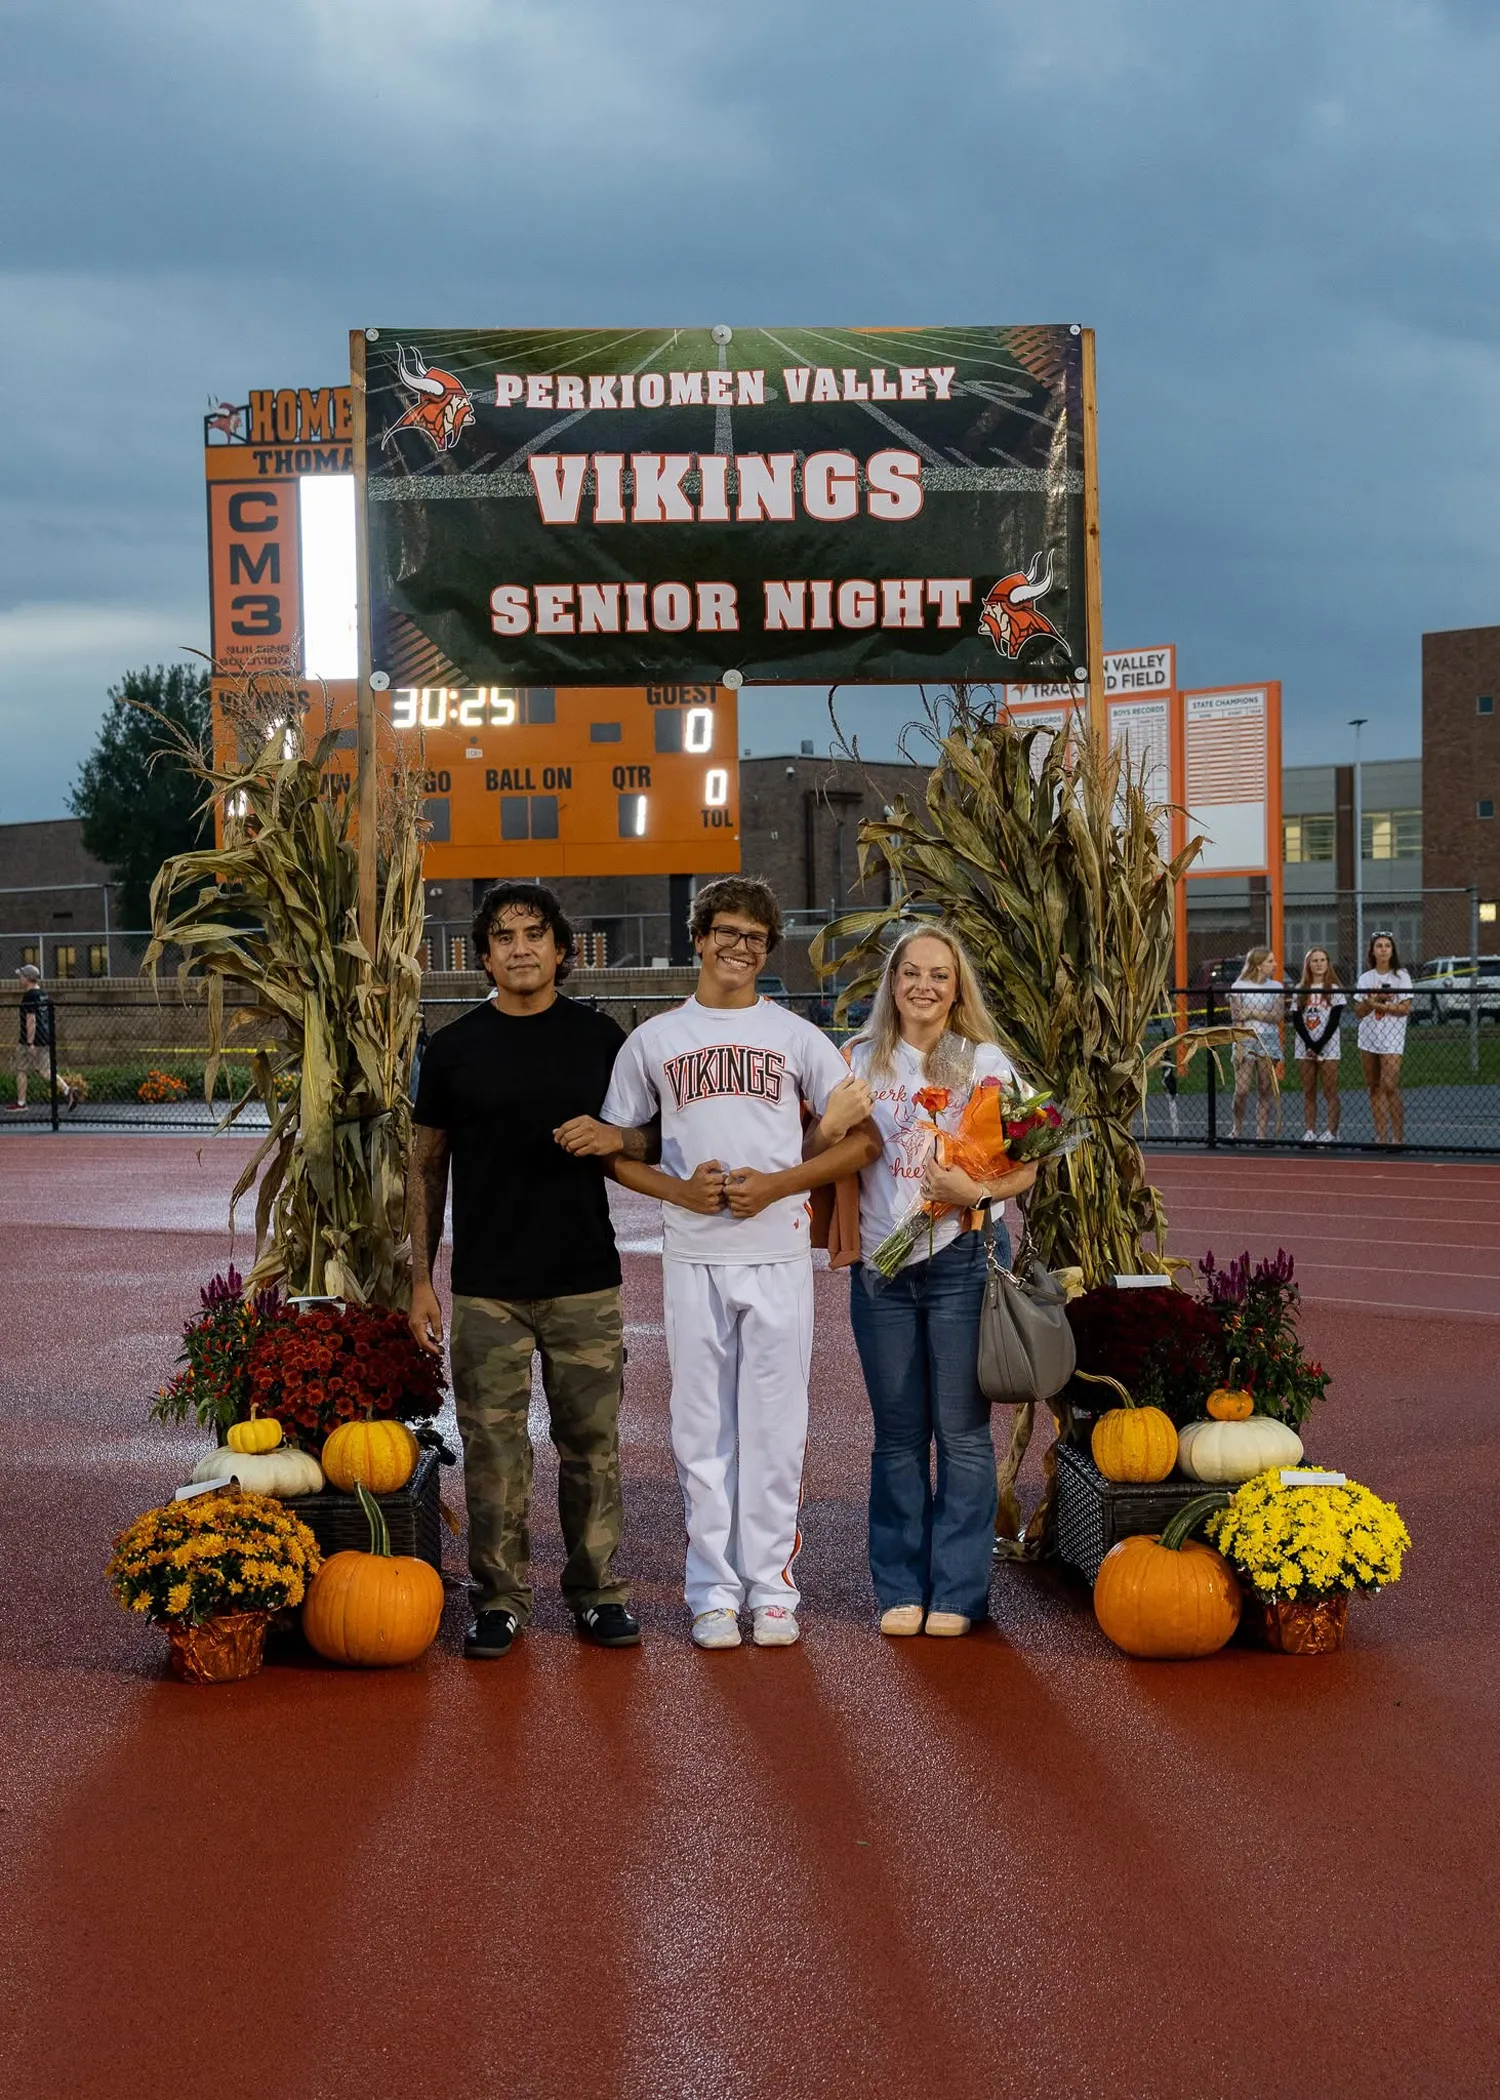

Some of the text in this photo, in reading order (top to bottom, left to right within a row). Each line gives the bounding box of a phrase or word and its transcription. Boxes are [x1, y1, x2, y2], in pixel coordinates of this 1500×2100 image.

[495, 366, 956, 410] PERKIOMEN VALLEY
[249, 384, 352, 444] HOME
[528, 449, 924, 526] VIKINGS
[490, 577, 973, 637] SENIOR NIGHT
[1113, 653, 1166, 673] VALLEY
[1032, 683, 1082, 699] TRACK
[1121, 670, 1166, 688] FIELD
[1192, 695, 1259, 710] STATE CHAMPIONS
[392, 686, 516, 729] 30:25
[1113, 705, 1165, 717] BOYS RECORDS
[685, 707, 714, 754] 0
[486, 766, 573, 791] BALL ON
[612, 765, 652, 791] QTR
[705, 768, 728, 806] 0
[701, 809, 734, 828] TOL
[663, 1044, 786, 1112] VIKINGS
